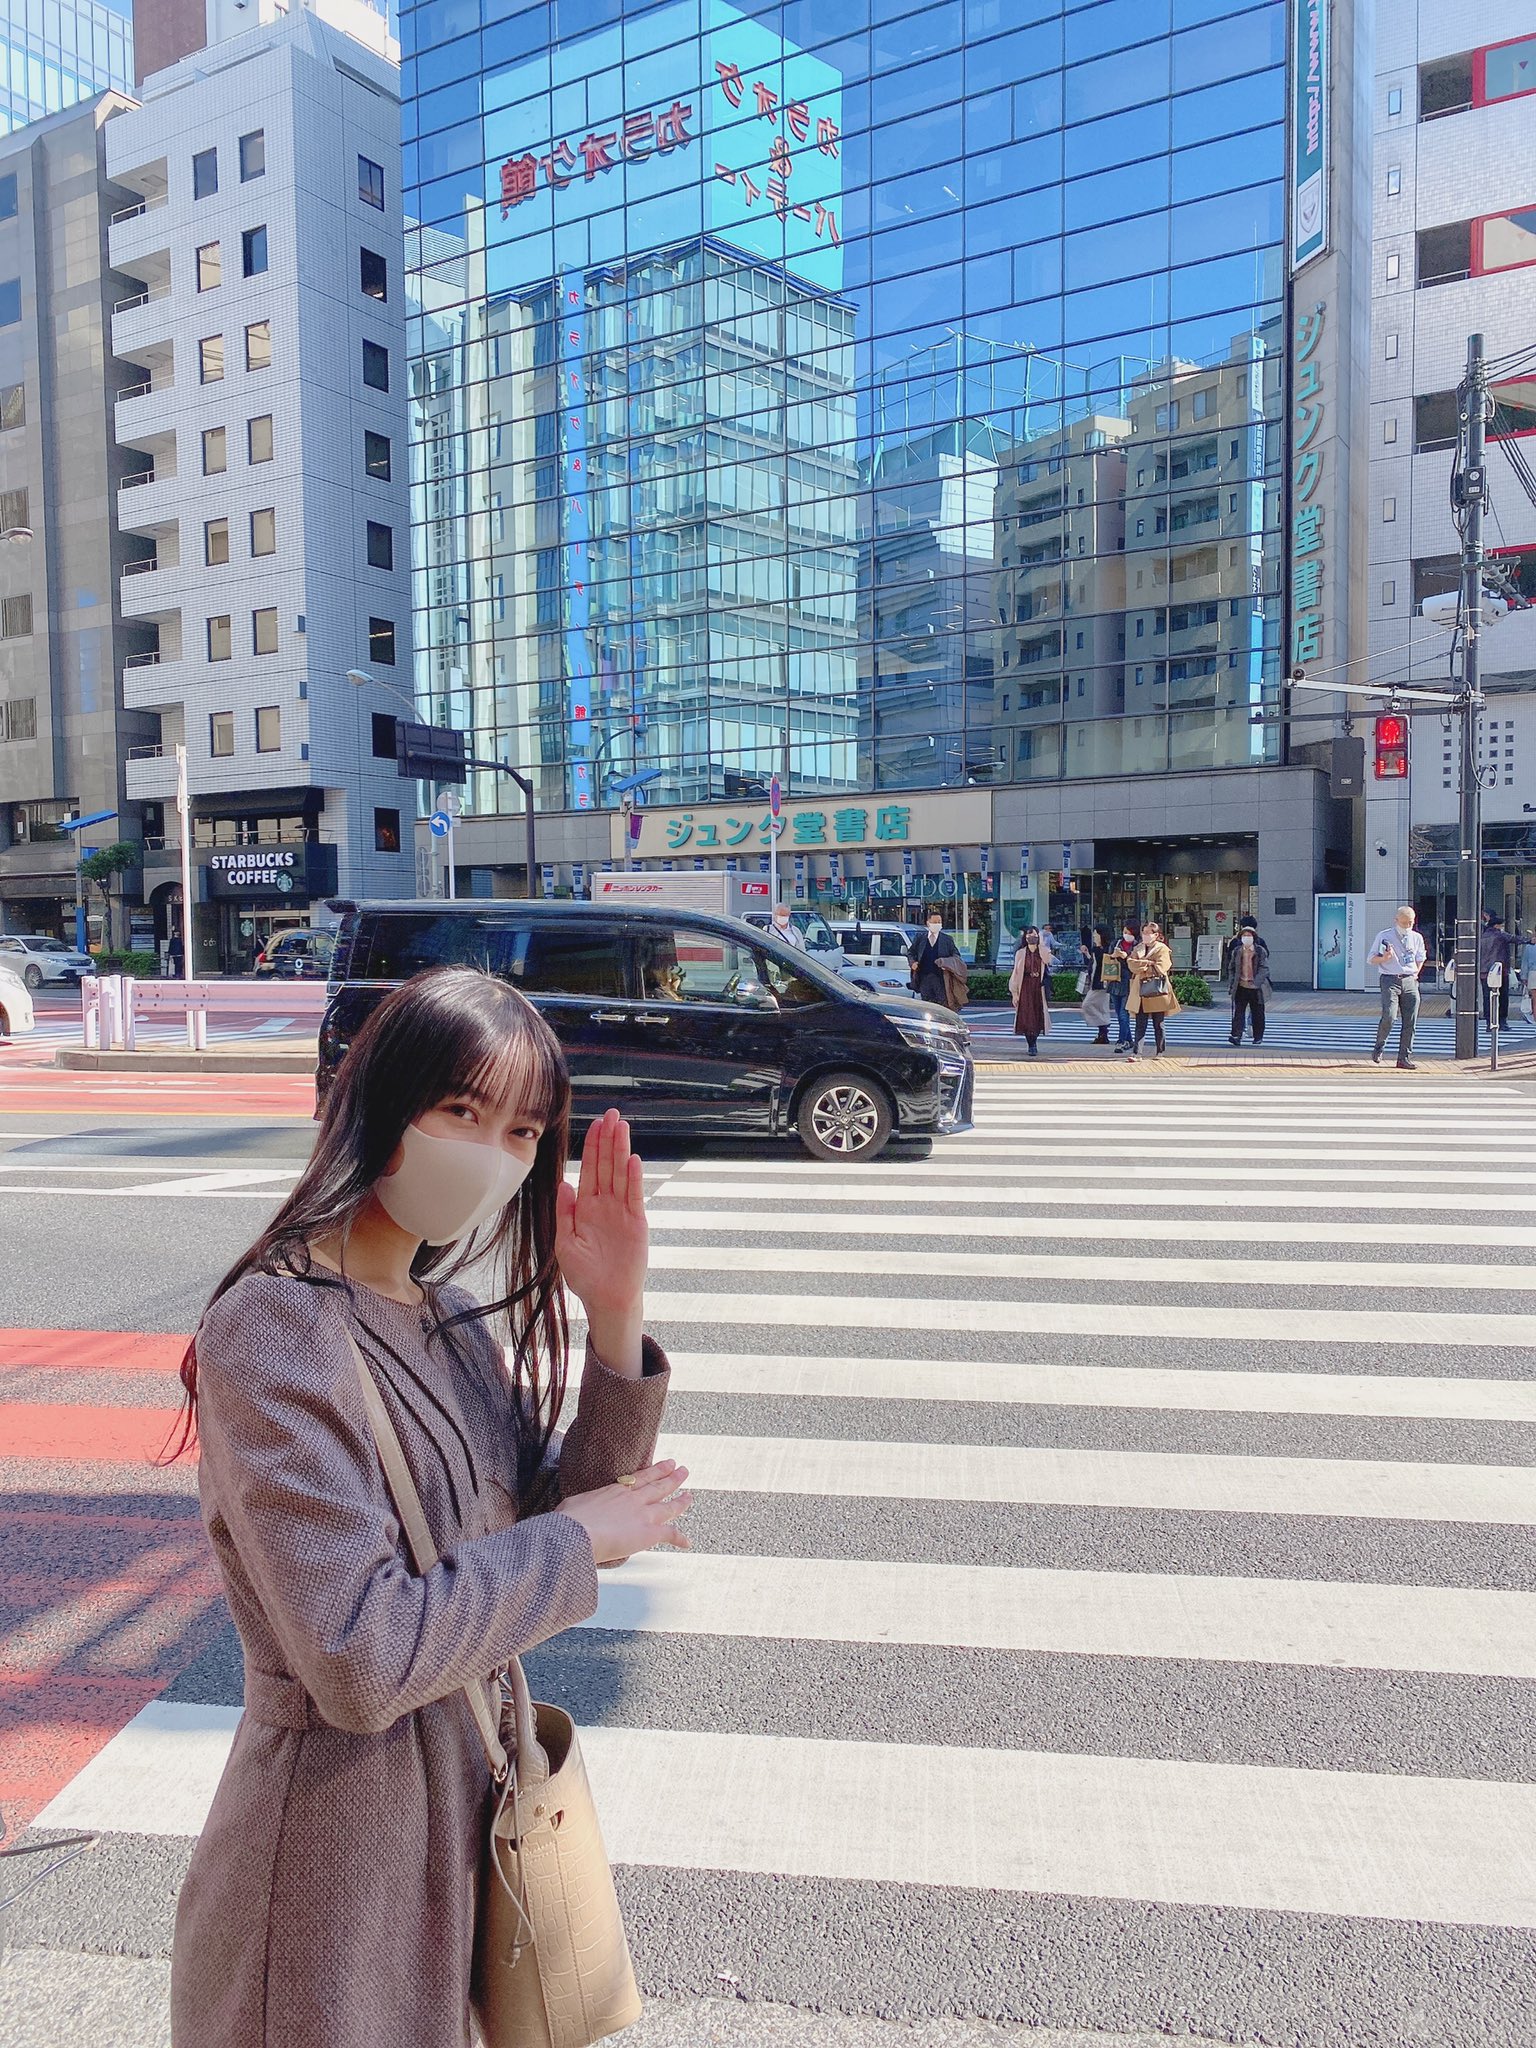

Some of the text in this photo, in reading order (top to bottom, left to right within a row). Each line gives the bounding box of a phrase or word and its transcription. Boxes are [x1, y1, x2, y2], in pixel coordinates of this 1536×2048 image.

[1293, 305, 1326, 664] ジュンク堂書店
[666, 805, 910, 849] ジュンク堂書店
[211, 852, 294, 869] STARBUCKS
[227, 870, 278, 885] COFFEE
[840, 878, 958, 900] JUNKUDO
